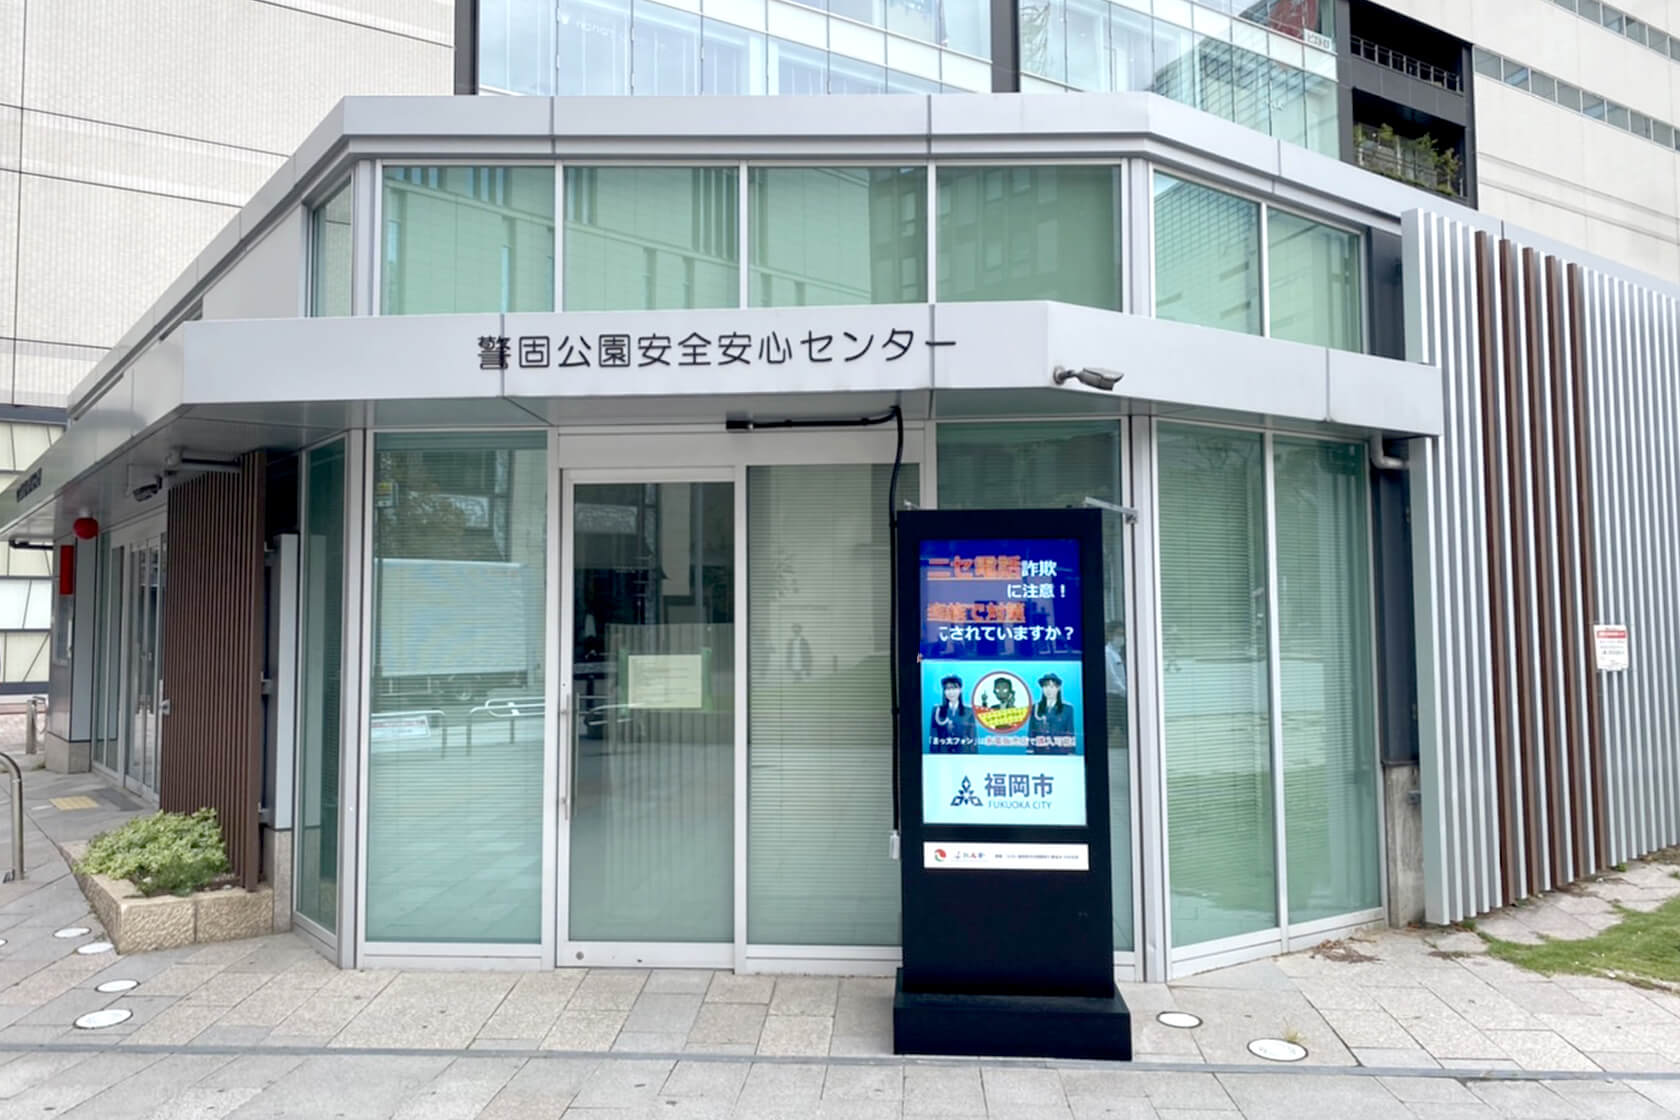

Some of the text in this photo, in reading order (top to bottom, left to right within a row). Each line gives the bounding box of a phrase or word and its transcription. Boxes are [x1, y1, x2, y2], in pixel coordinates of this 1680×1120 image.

[477, 327, 957, 371] 警固公園安全安心センター
[984, 773, 1054, 798] 福岡市
[988, 800, 1053, 810] FUKUOKA CITY
